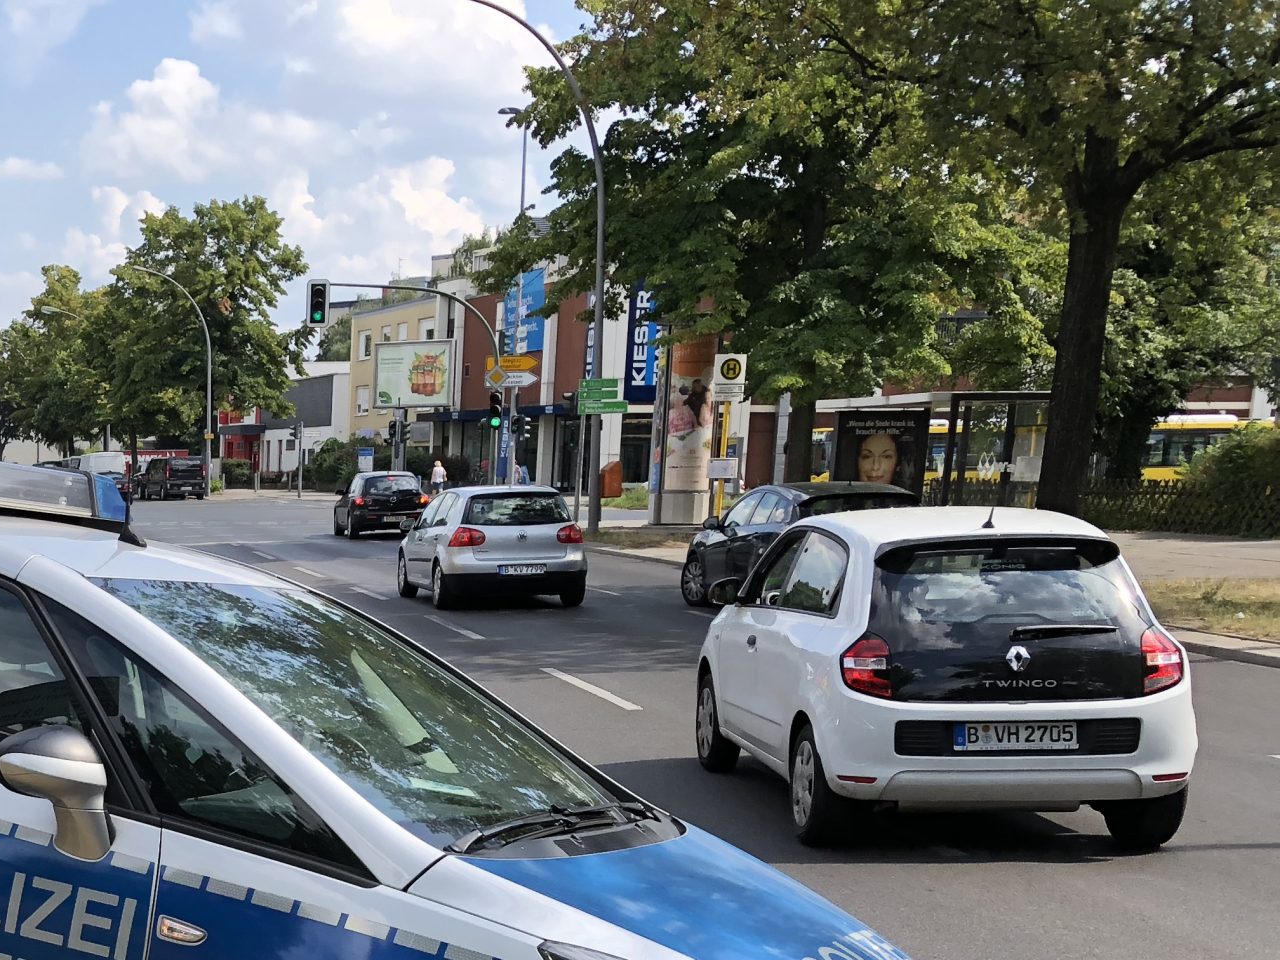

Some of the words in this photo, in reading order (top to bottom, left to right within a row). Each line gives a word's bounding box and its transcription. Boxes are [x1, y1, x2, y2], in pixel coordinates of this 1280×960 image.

[726, 363, 737, 375] H
[981, 679, 1058, 688] TWINGO
[967, 726, 980, 743] B
[994, 725, 1020, 743] VH
[1024, 725, 1074, 743] 2705
